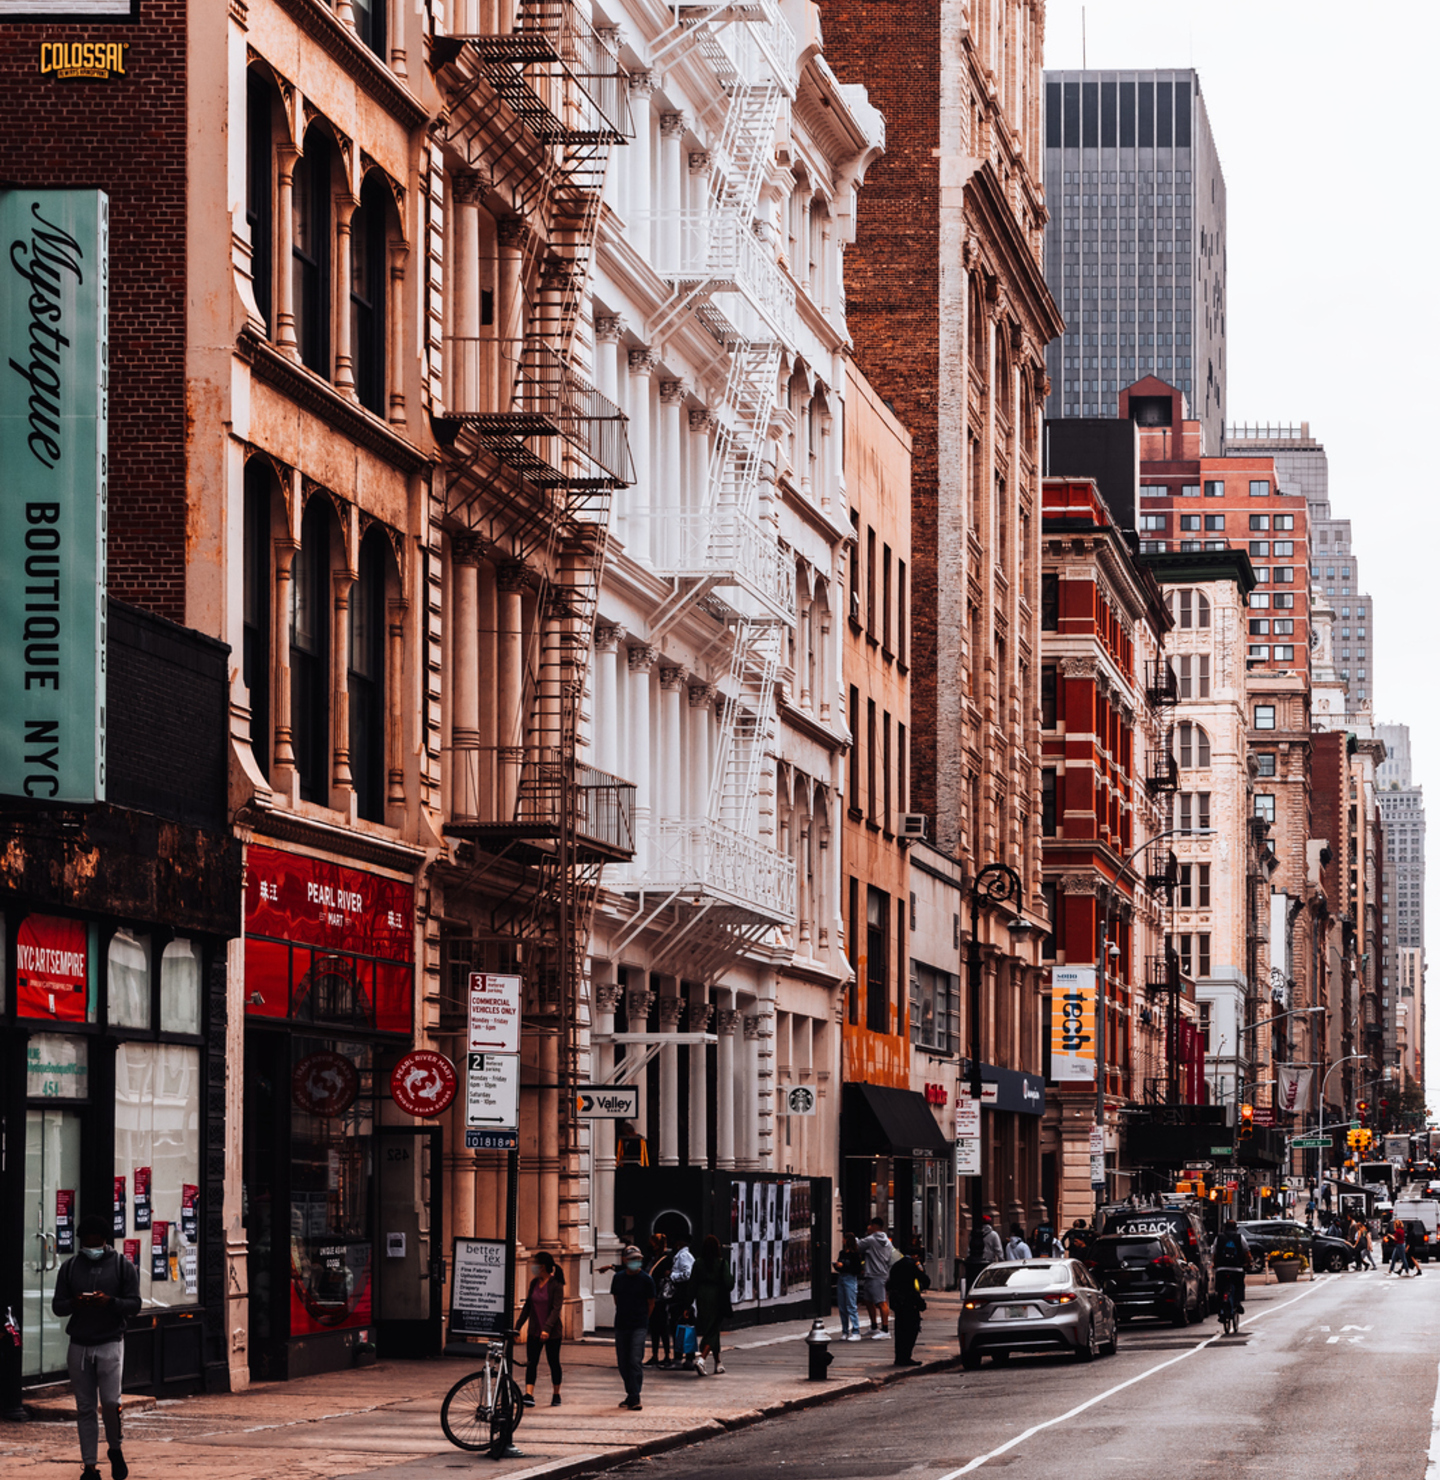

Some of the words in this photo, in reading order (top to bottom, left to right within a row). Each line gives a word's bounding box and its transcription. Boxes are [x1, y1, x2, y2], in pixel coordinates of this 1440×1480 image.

[41, 42, 126, 75] COLOSSAL
[101, 200, 109, 421] MYSTIQUE
[8, 202, 84, 470] Mystique
[100, 453, 108, 673] BOUTIQUE
[23, 501, 61, 691] BOUTIQUE
[23, 720, 60, 798] NYC
[307, 881, 336, 907] PEARL
[337, 889, 363, 913] RIVER
[327, 912, 344, 928] MART
[17, 944, 85, 978] NYCARTSEMPIRE
[474, 976, 483, 990] 3
[472, 997, 511, 1006] COMMERCIAL
[472, 1006, 500, 1015] VEHICLES
[501, 1007, 516, 1015] ONLY
[1061, 992, 1092, 1051] tech
[395, 1058, 415, 1079] PEARL
[414, 1054, 438, 1063] RIVER
[437, 1060, 453, 1079] MART
[472, 1054, 481, 1069] 2
[42, 1080, 59, 1097] 454
[1285, 1081, 1298, 1110] SALLY
[596, 1096, 632, 1113] Valley
[467, 1137, 504, 1148] 101818
[466, 1243, 500, 1255] better
[484, 1254, 501, 1264] tex
